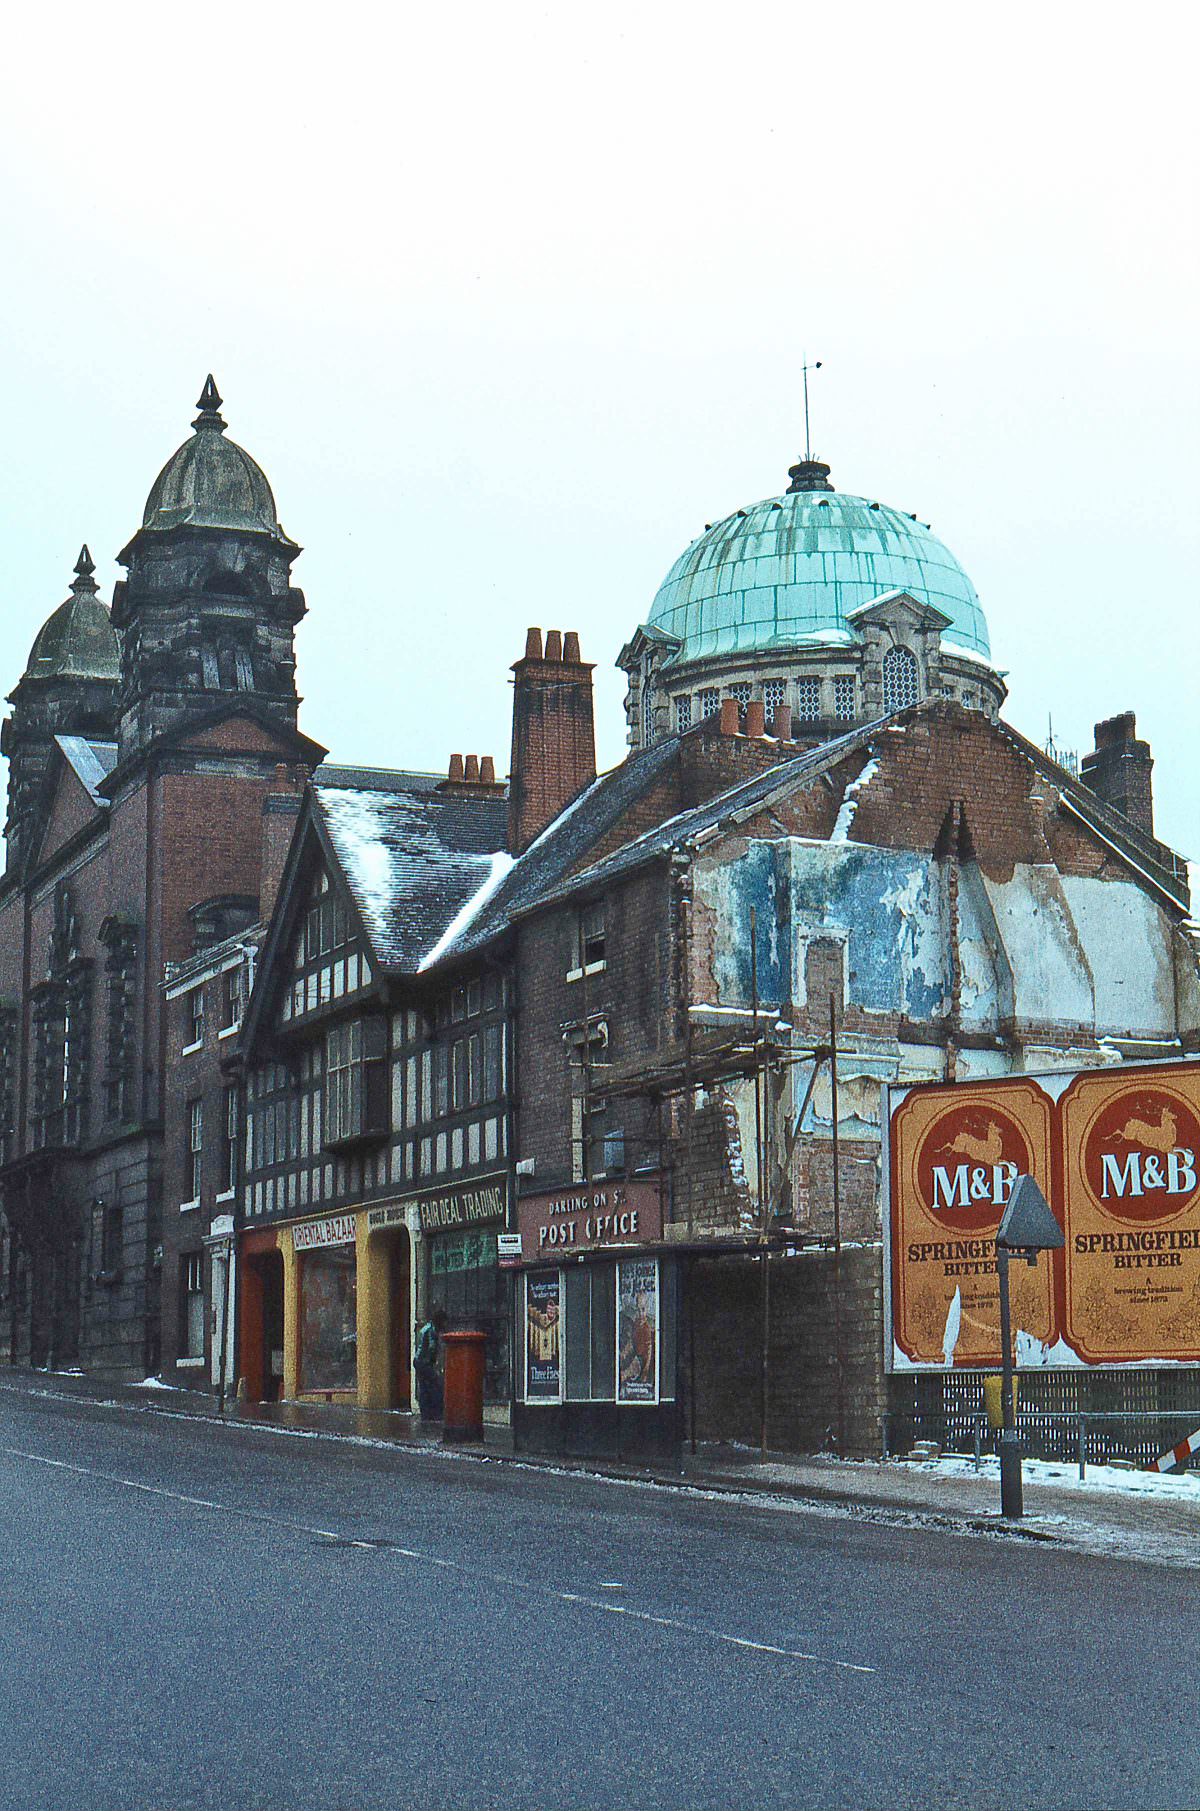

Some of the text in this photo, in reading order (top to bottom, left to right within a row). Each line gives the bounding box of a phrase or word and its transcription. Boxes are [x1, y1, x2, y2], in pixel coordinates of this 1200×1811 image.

[932, 1161, 1019, 1208] M&B
[1101, 1148, 1197, 1198] M&B
[421, 1202, 440, 1229] FAIR
[440, 1196, 462, 1224] DEAL
[462, 1187, 503, 1220] TRADING
[550, 1192, 607, 1216] DARLINGON
[539, 1221, 575, 1246] POST
[908, 1238, 1027, 1262] SPRINGF
[1114, 1253, 1183, 1268] BITTER
[1114, 1284, 1183, 1297] brewing tradition
[1146, 1277, 1152, 1285] A
